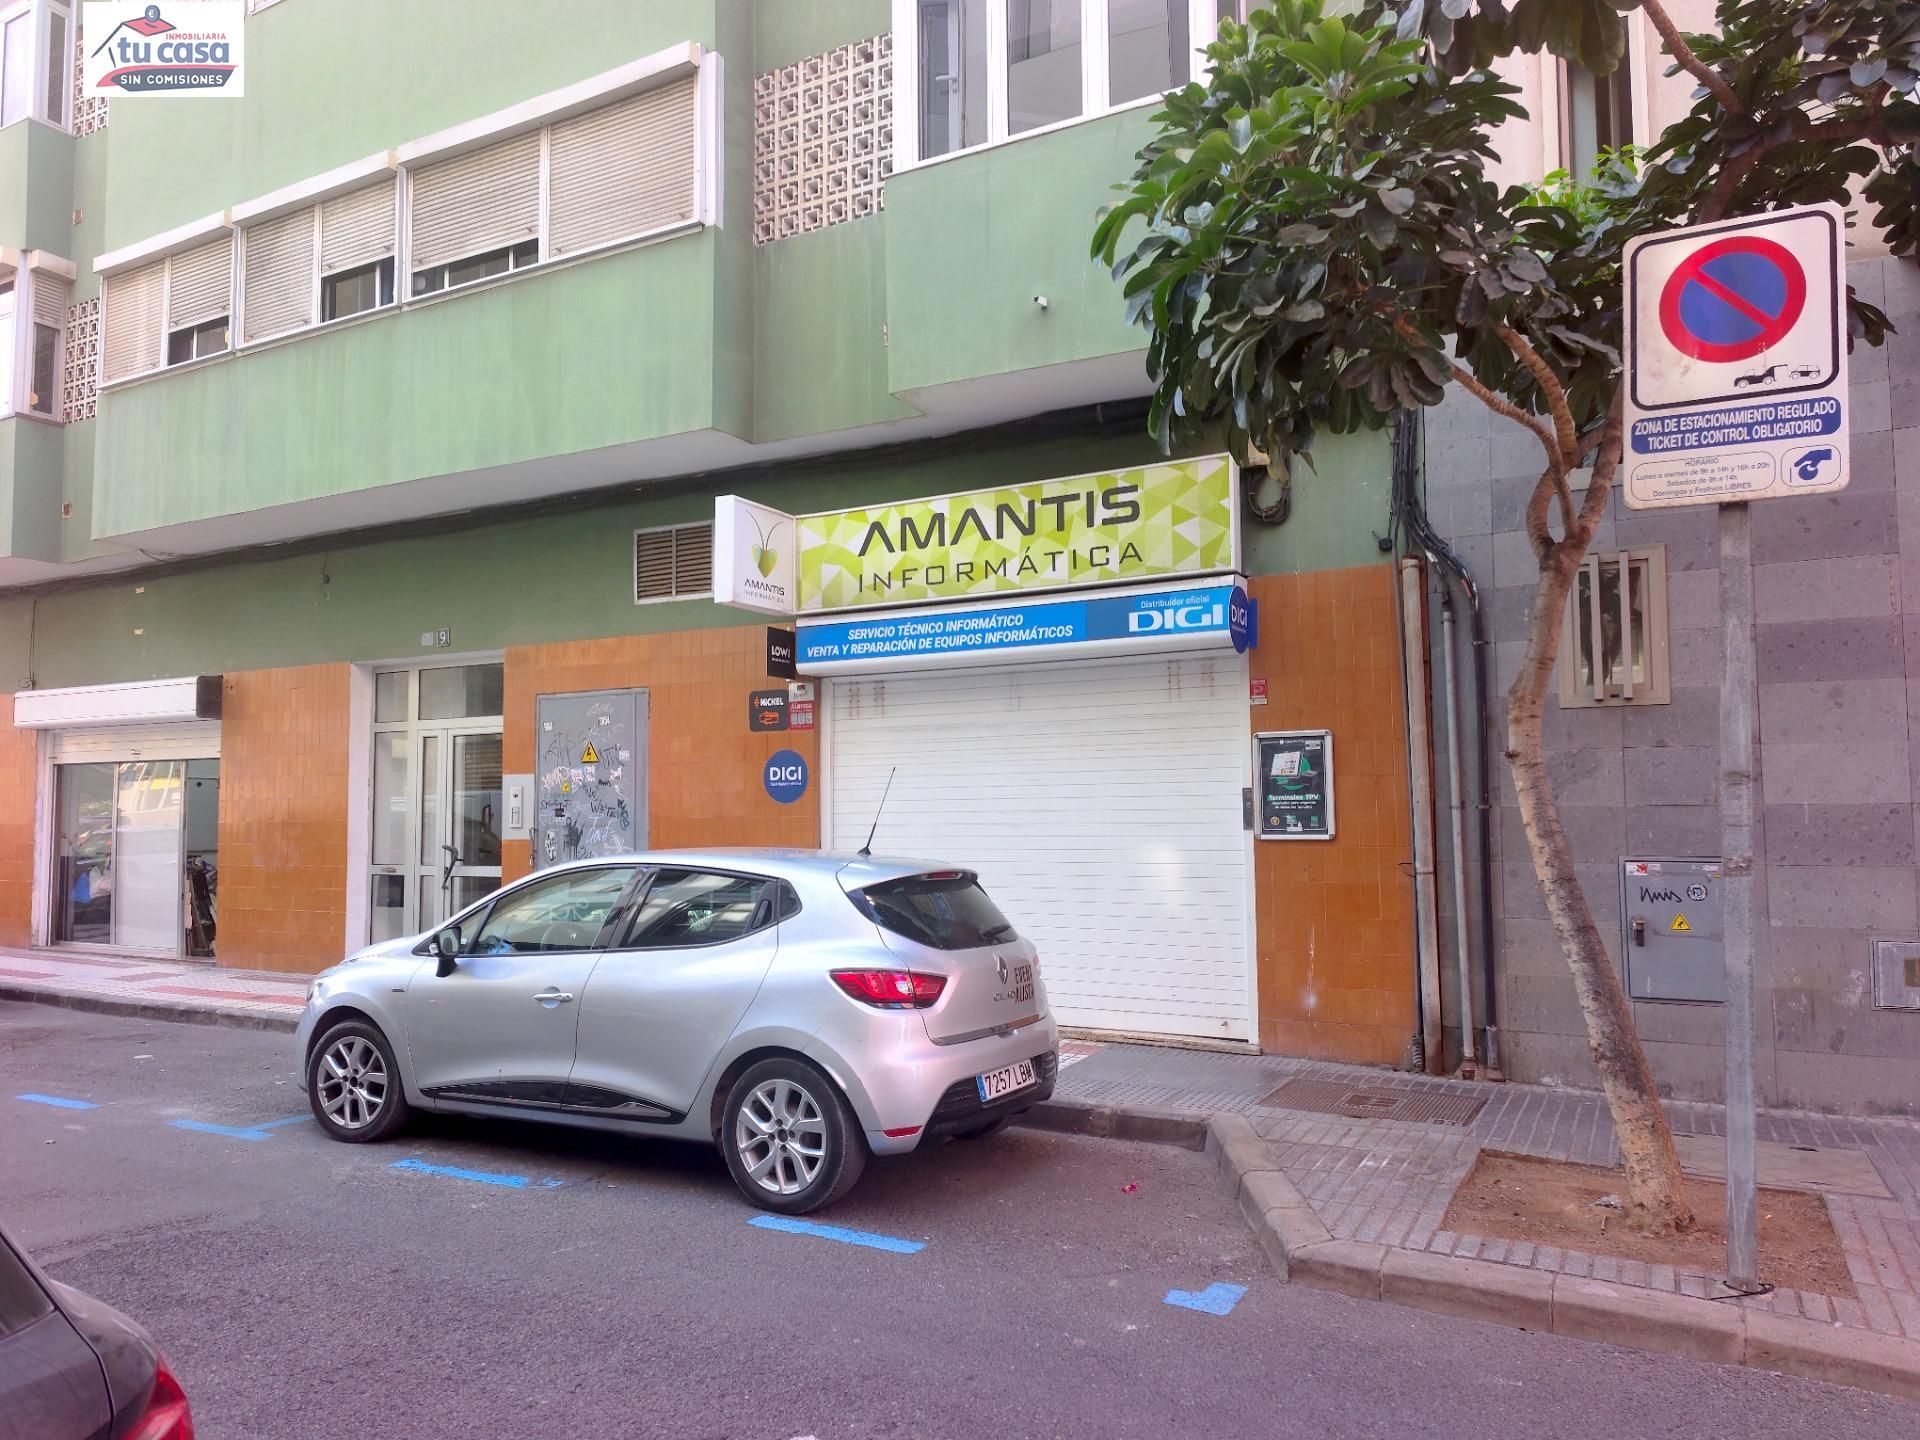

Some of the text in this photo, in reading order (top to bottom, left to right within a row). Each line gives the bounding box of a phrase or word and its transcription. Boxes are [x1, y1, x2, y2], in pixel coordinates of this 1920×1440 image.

[1634, 400, 1836, 436] ZONA DE ESTACIONAMIENTO REGULADO
[1648, 418, 1822, 450] TICKET DE CONTROL OBLIGATORIO
[1685, 457, 1719, 467] HORARIO
[1636, 473, 1657, 481] Lunes
[1725, 482, 1752, 491] LIBRES
[858, 484, 1141, 557] AMANTIS
[858, 541, 1144, 593] INFORMÁTICA
[745, 579, 785, 596] AMANTIS
[1141, 594, 1210, 609] Distribuidor oficial
[848, 613, 1024, 640] SERVICIO TÉCNICO INFORMÁTICO
[1128, 603, 1224, 633] DIGI
[1231, 604, 1248, 627] DIGI
[439, 631, 446, 644] 9
[807, 624, 1073, 658] VENTA Y REPARACIÓN DE EQUIPOS INFORMÁTICOS
[769, 766, 802, 781] DIGI
[1305, 793, 1319, 801] TPV
[984, 1071, 1012, 1096] 7257
